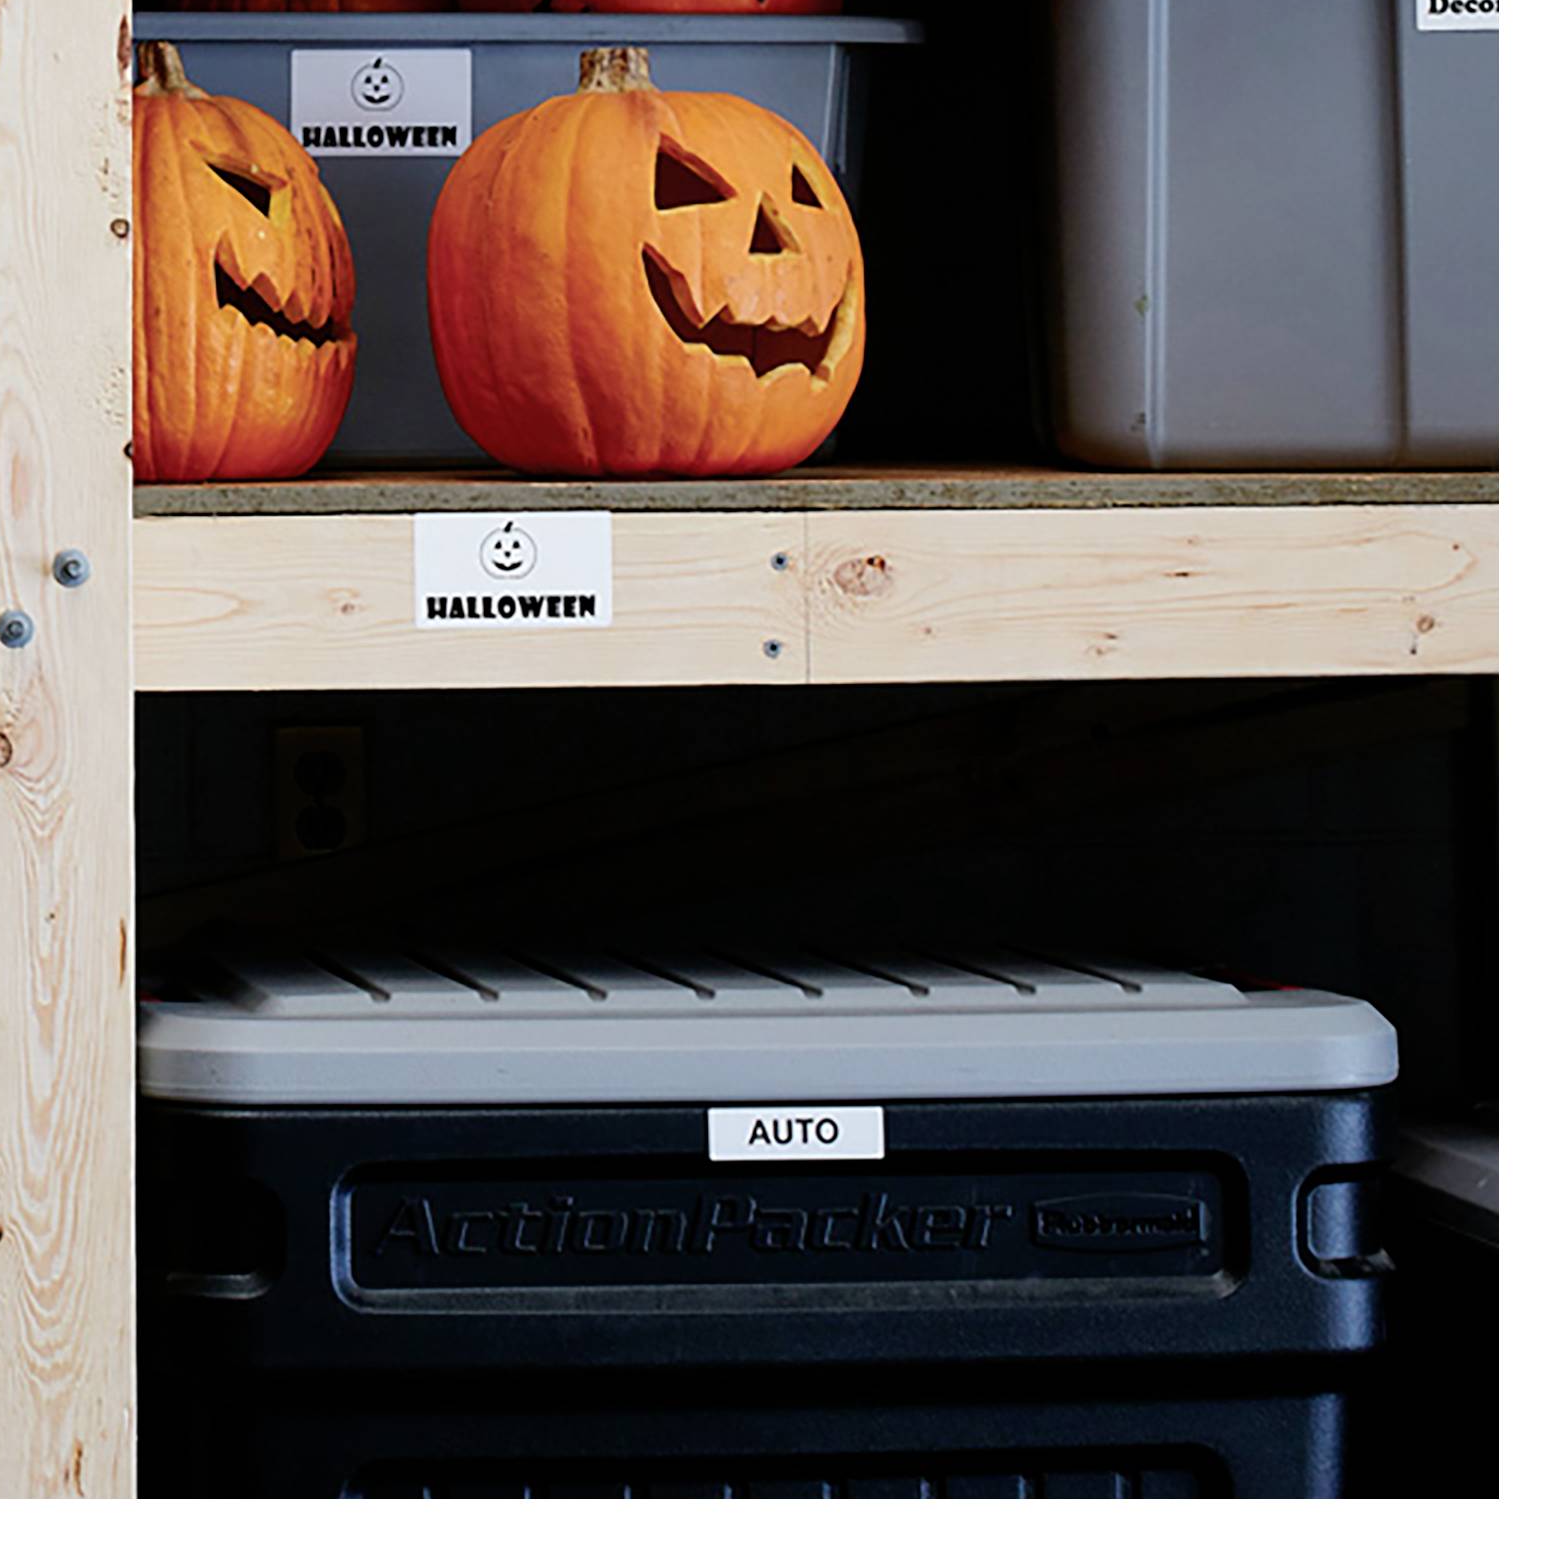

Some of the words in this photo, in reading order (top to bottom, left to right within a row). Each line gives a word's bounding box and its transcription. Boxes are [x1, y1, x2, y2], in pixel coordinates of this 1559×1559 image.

[302, 124, 458, 148] HALLOWEEN
[426, 594, 596, 620] HALLOWEEN
[748, 1117, 840, 1145] AUTO
[372, 1192, 1012, 1255] ActionPacker
